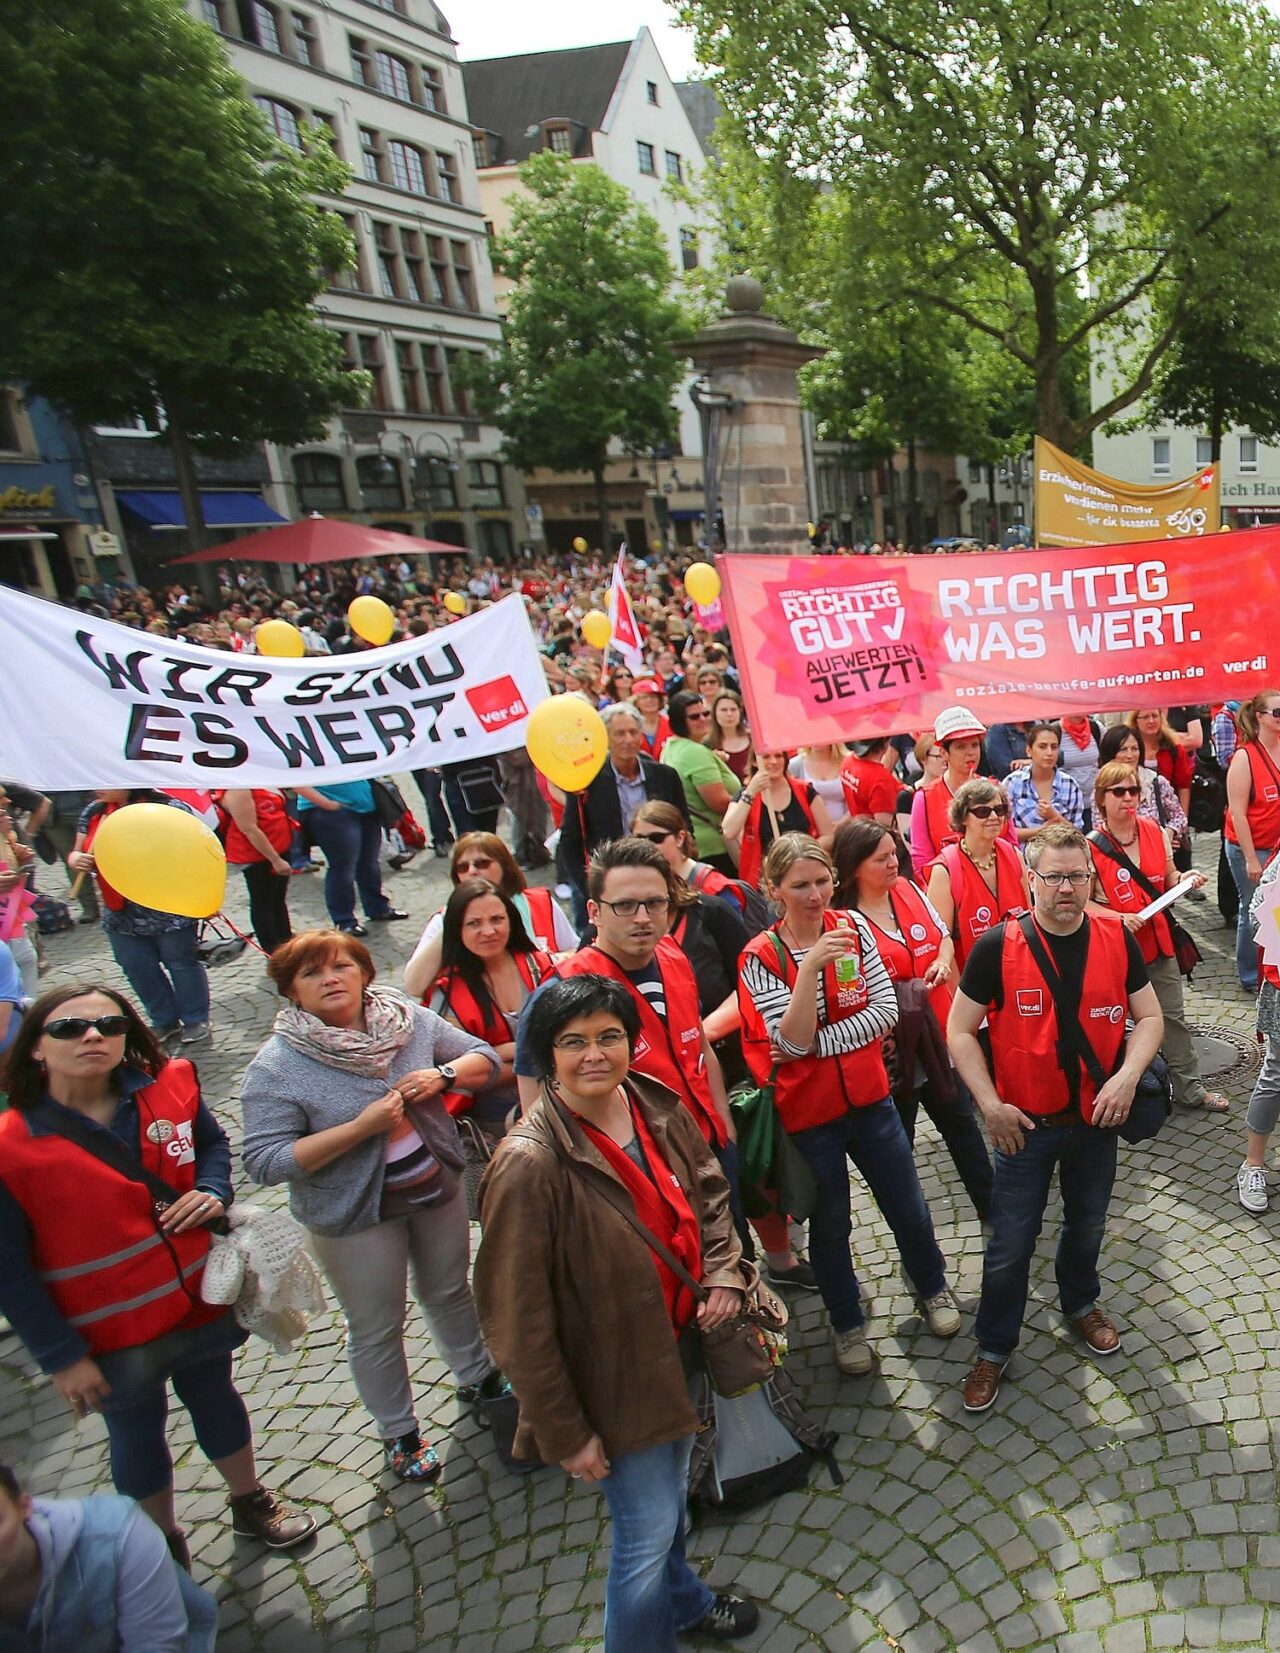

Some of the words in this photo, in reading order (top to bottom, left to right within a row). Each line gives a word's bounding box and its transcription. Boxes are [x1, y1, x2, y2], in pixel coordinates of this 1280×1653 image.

[782, 586, 901, 621] RICHTIG
[938, 560, 1169, 618] RICHTIG
[789, 610, 875, 655] GUT
[943, 618, 1046, 663] WAS
[1067, 603, 1202, 655] WERT.
[76, 629, 273, 707] WIR
[806, 643, 918, 678] AUFWERTEN
[810, 656, 927, 704] JETZT!
[955, 665, 1205, 698] soziale-berufe-aufwerten.de
[124, 702, 250, 768] ES
[253, 692, 468, 769] WERT.
